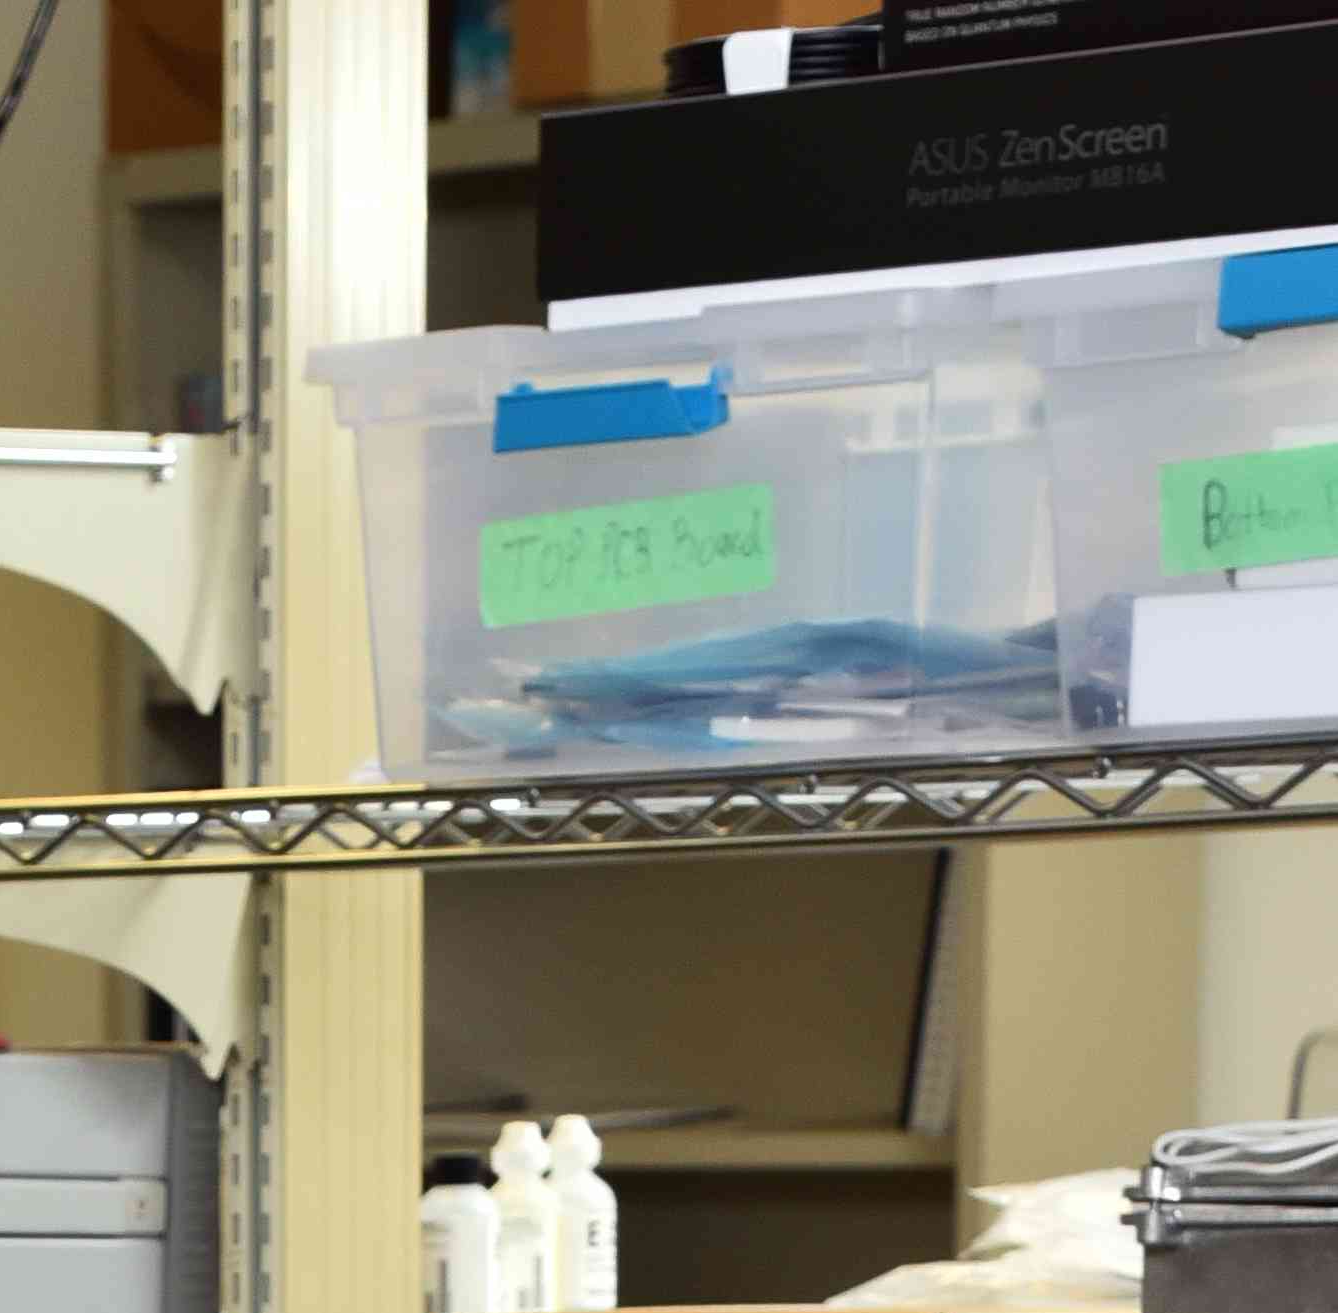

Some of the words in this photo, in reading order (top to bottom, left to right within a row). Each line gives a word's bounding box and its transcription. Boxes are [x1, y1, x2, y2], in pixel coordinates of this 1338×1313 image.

[908, 133, 989, 177] ASUS
[905, 183, 994, 208] Portable
[998, 174, 1083, 199] Monitor
[501, 526, 582, 590] TOP
